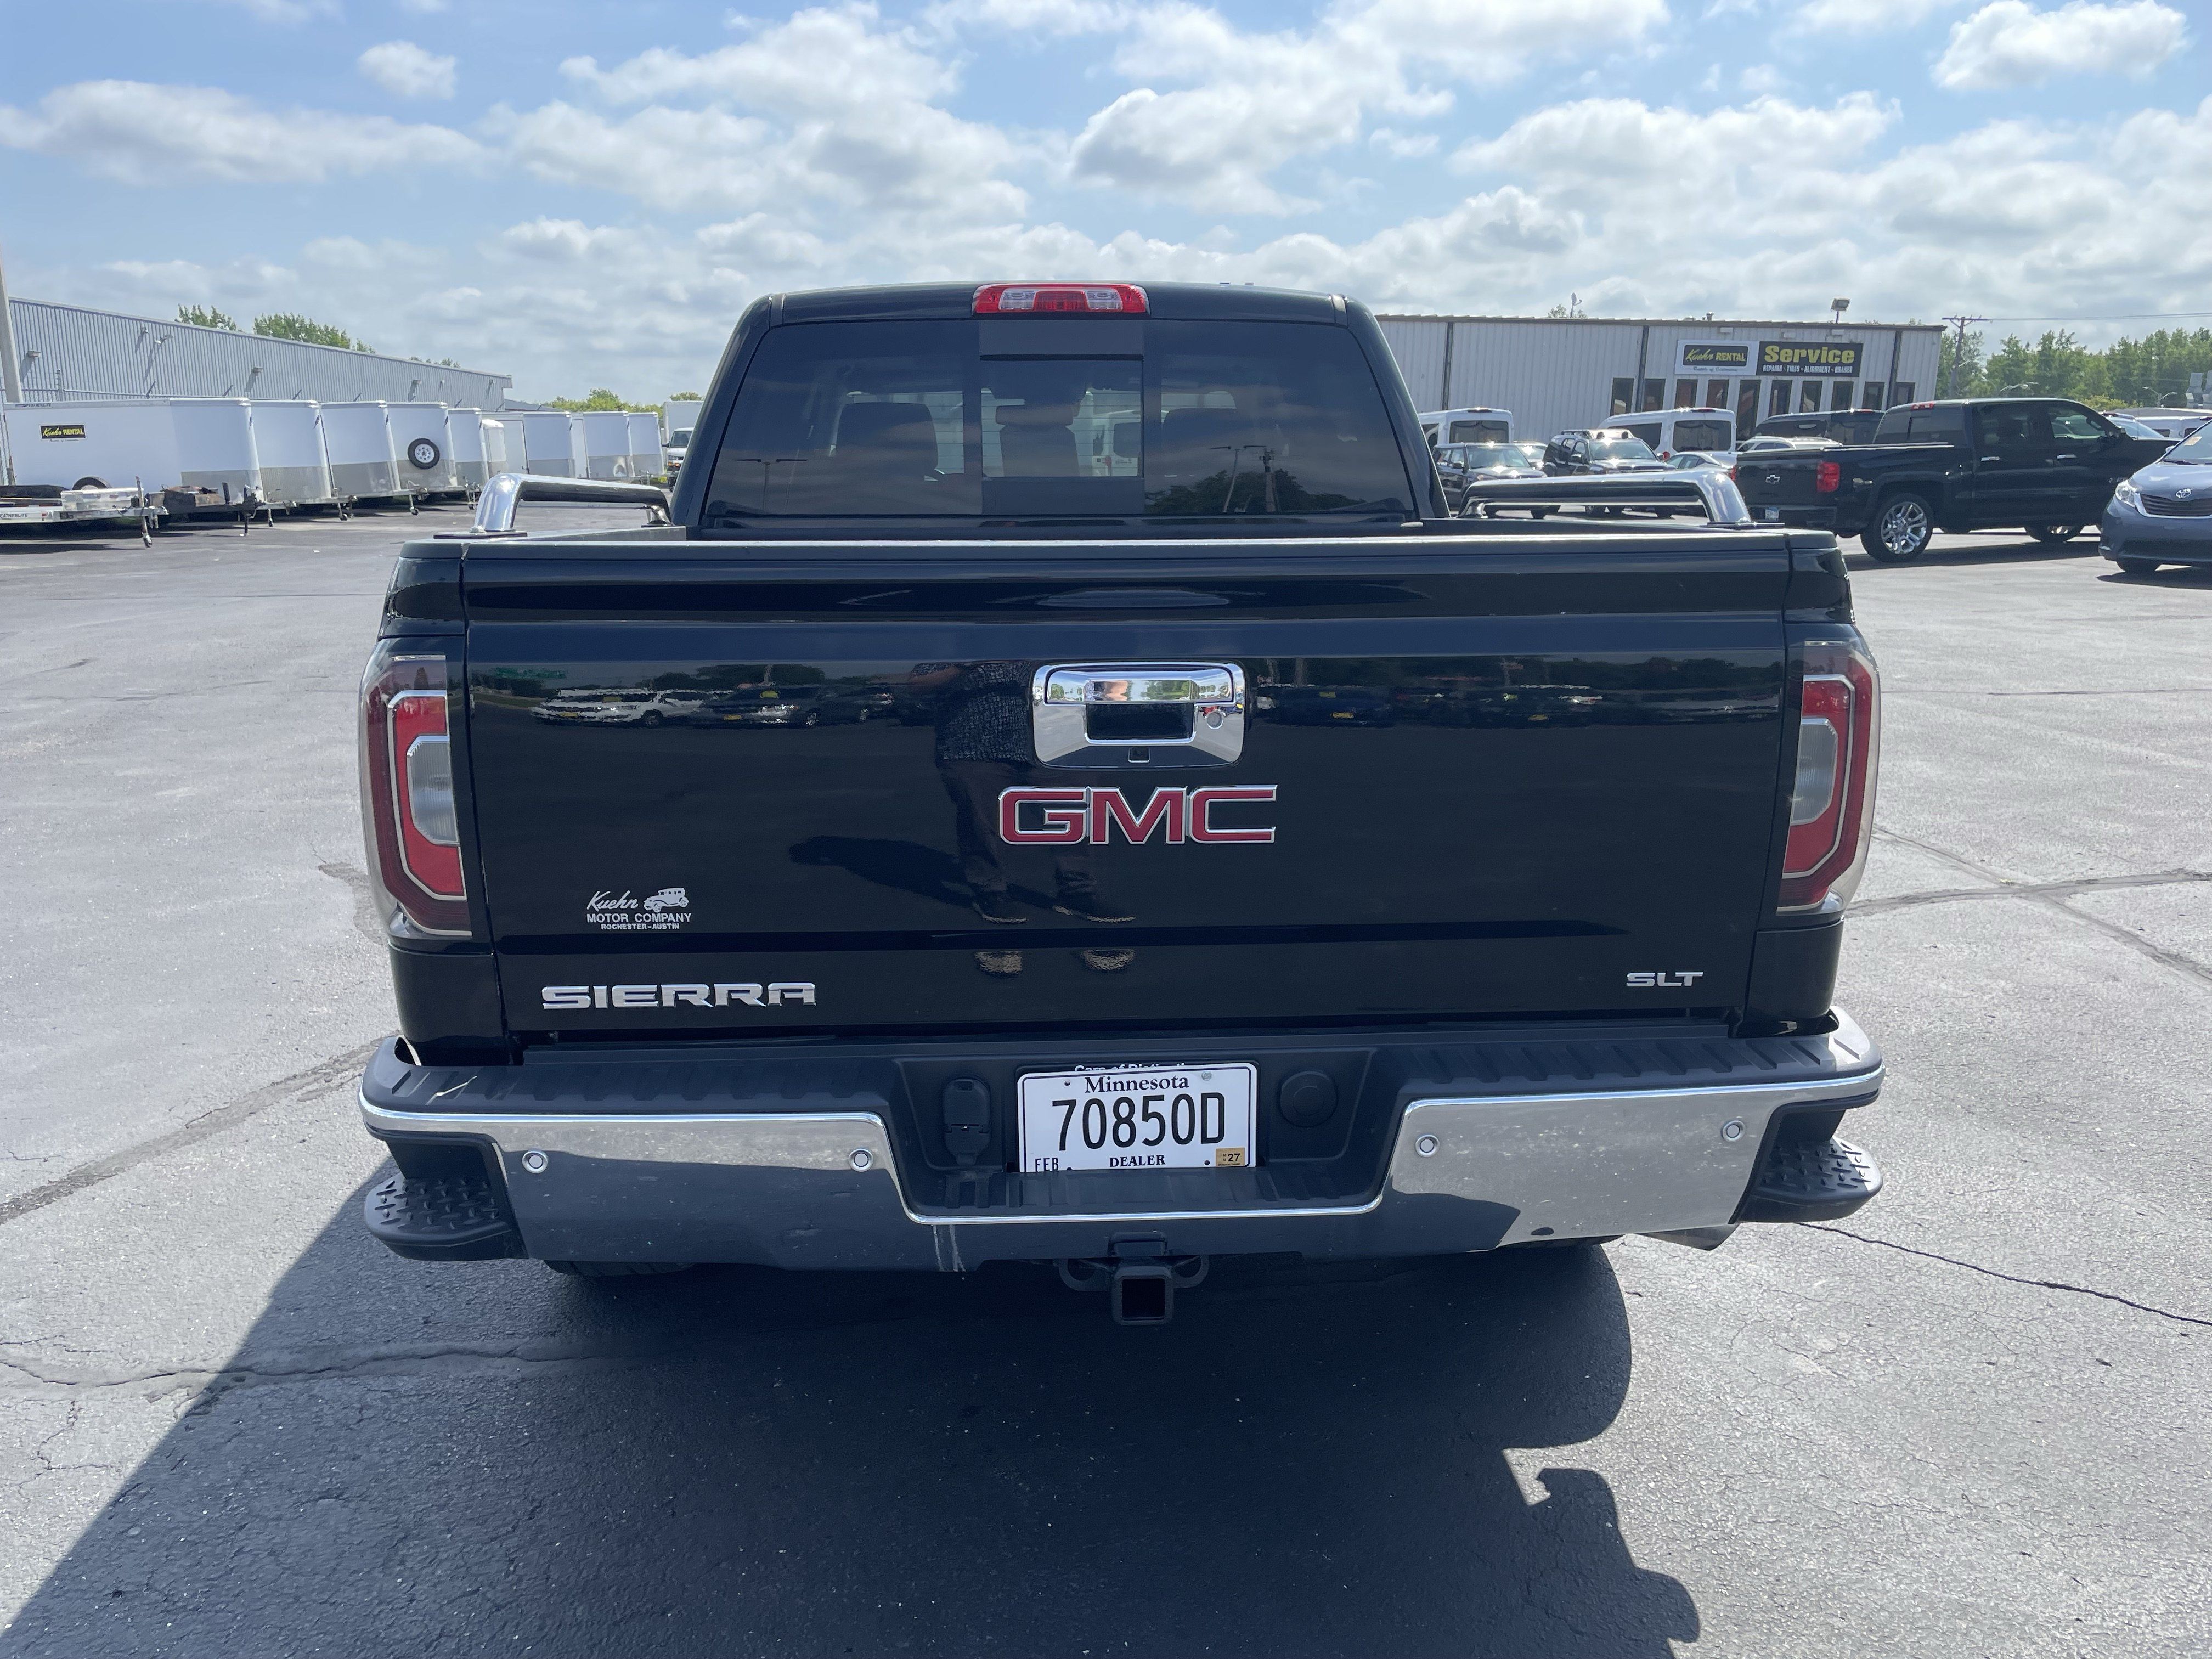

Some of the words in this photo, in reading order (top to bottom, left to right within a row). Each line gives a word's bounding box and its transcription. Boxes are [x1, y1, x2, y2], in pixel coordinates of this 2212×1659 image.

[1716, 352, 1746, 362] RENTAL
[1764, 345, 1855, 364] Service
[998, 785, 1278, 845] GMC
[586, 890, 639, 912] Kuehn
[586, 913, 629, 923] MOTOR
[634, 913, 691, 923] COMPANY
[1626, 972, 1703, 987] SLT
[541, 982, 817, 1009] SIERRA
[1085, 1075, 1189, 1093] Minnesota
[1052, 1092, 1225, 1152] 70850D
[1035, 1157, 1059, 1172] FEB
[1109, 1154, 1166, 1167] DEALER
[1227, 1153, 1240, 1162] 27
